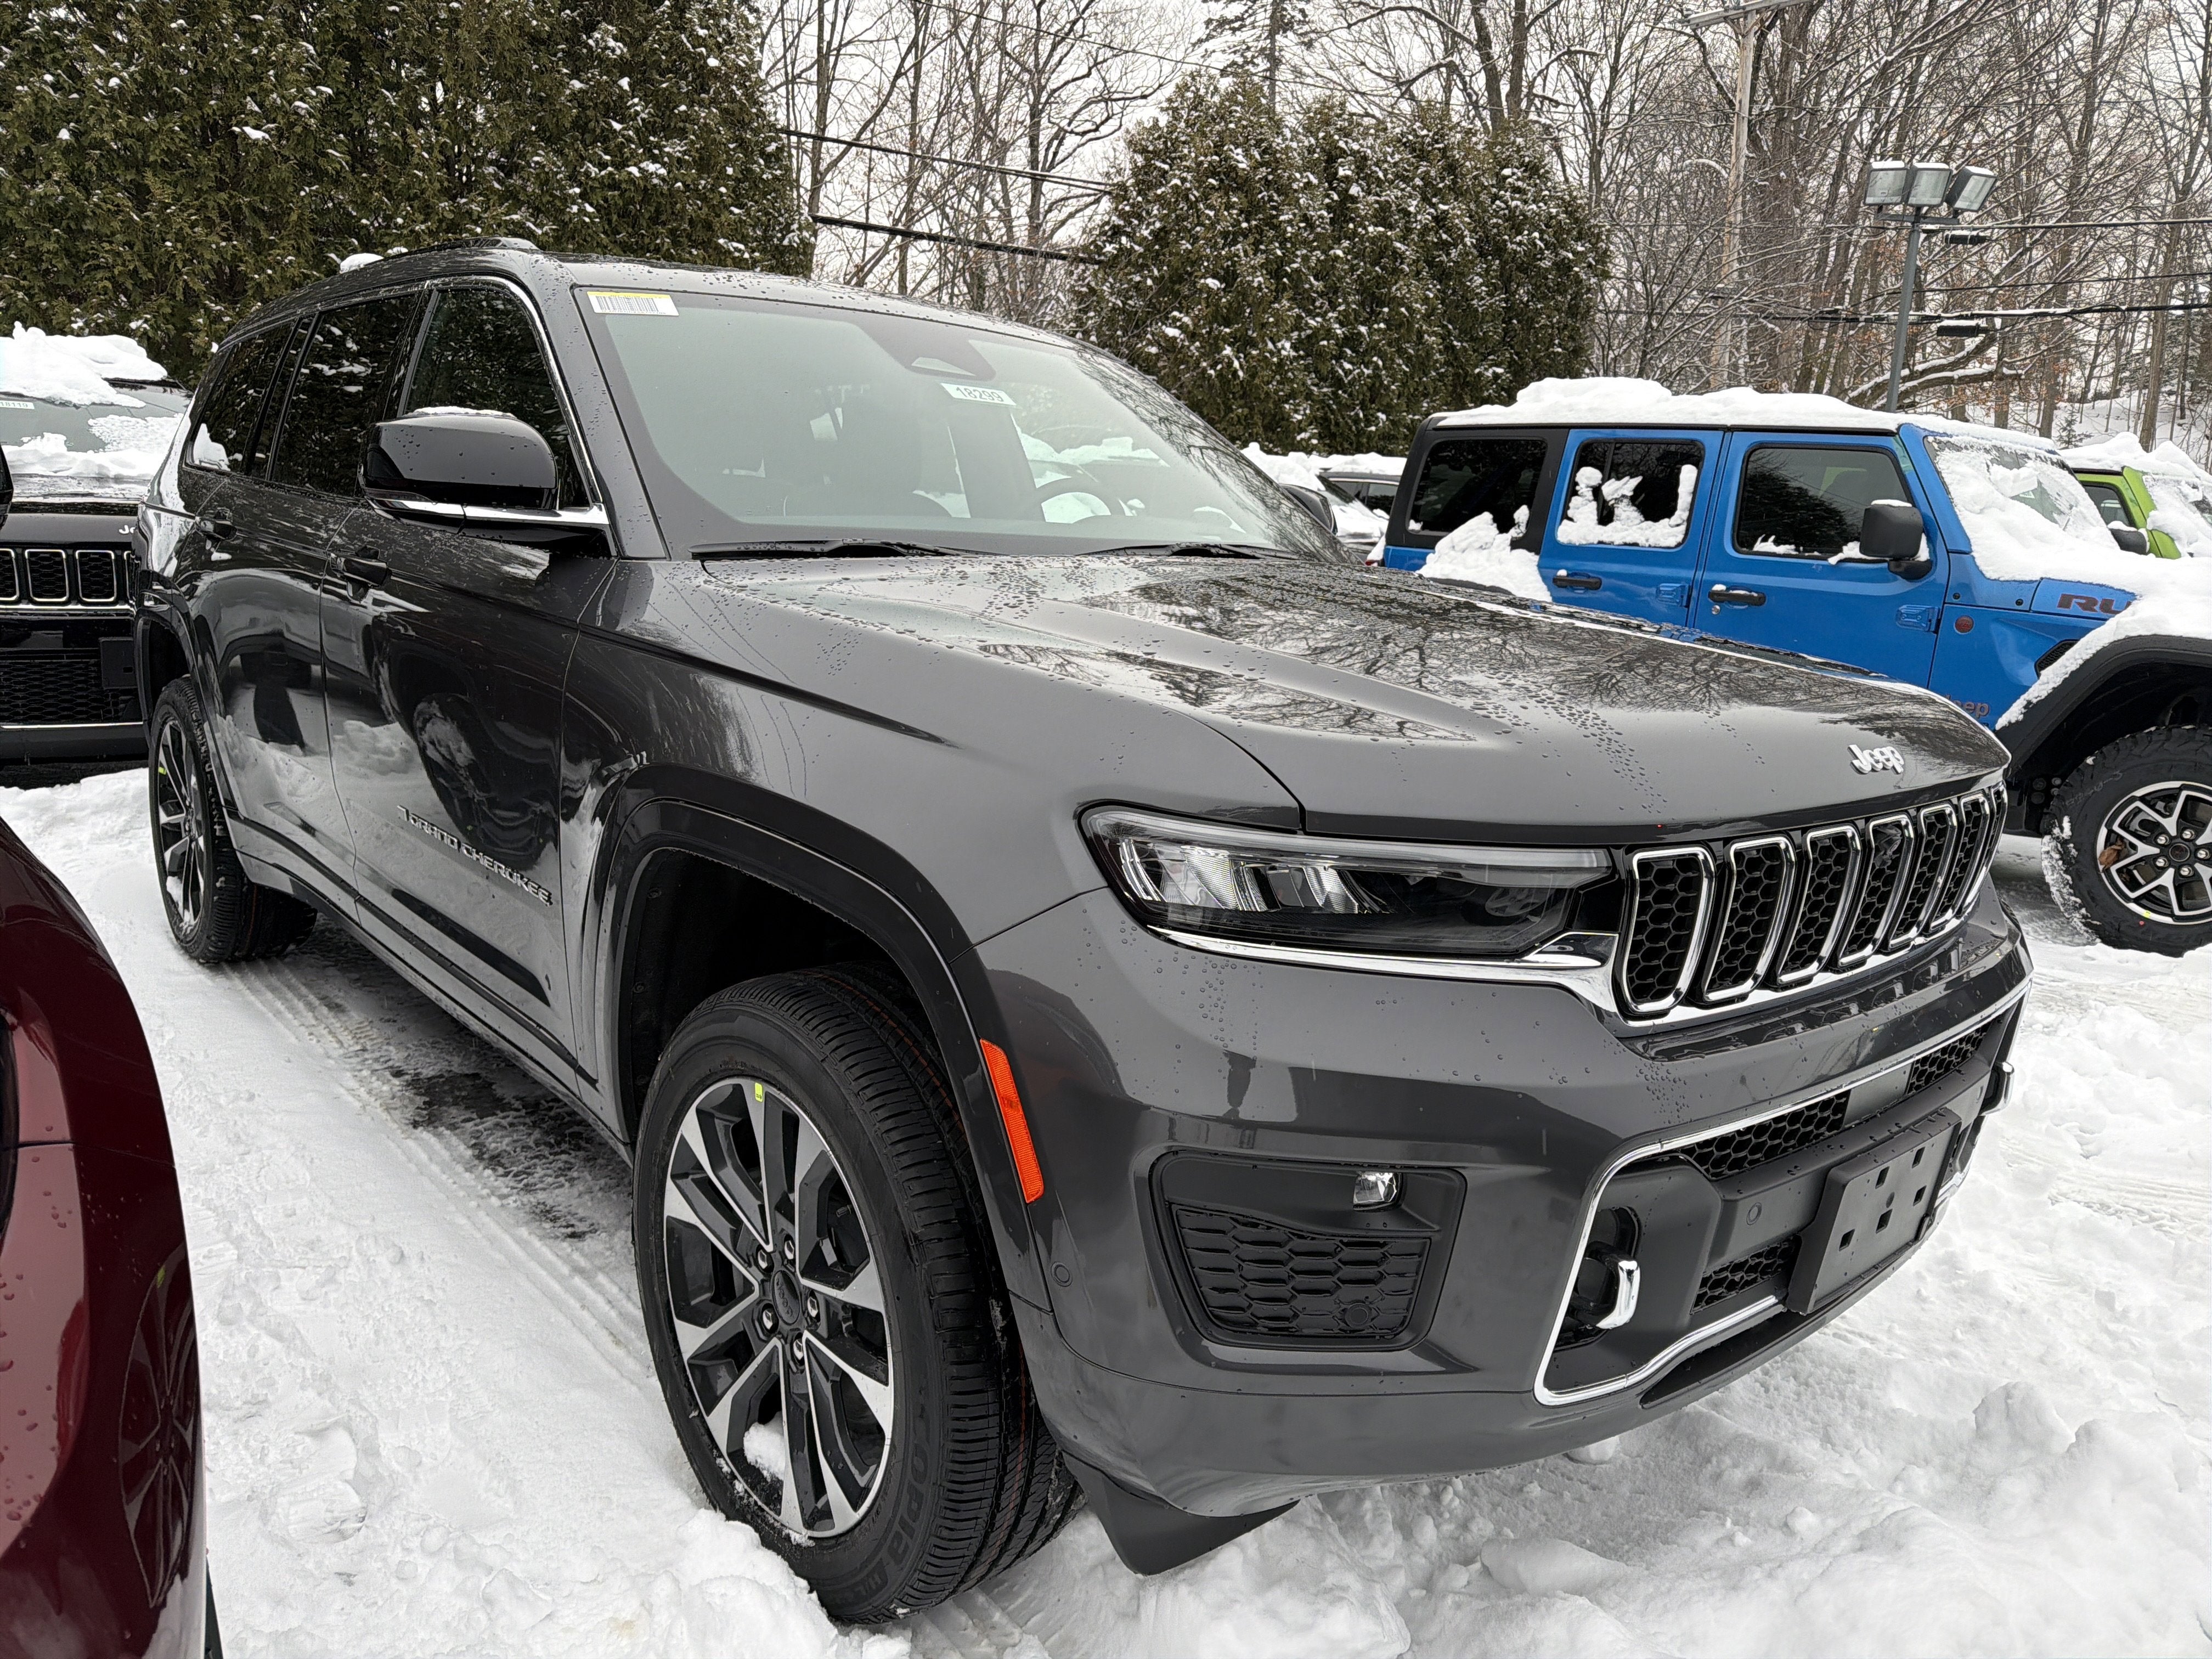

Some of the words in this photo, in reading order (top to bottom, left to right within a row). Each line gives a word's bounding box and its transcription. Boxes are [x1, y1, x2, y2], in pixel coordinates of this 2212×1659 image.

[956, 387, 1004, 402] 18299
[1848, 744, 1904, 774] Jeep
[409, 813, 460, 850] GRAND
[461, 843, 553, 907] CHEROKEE
